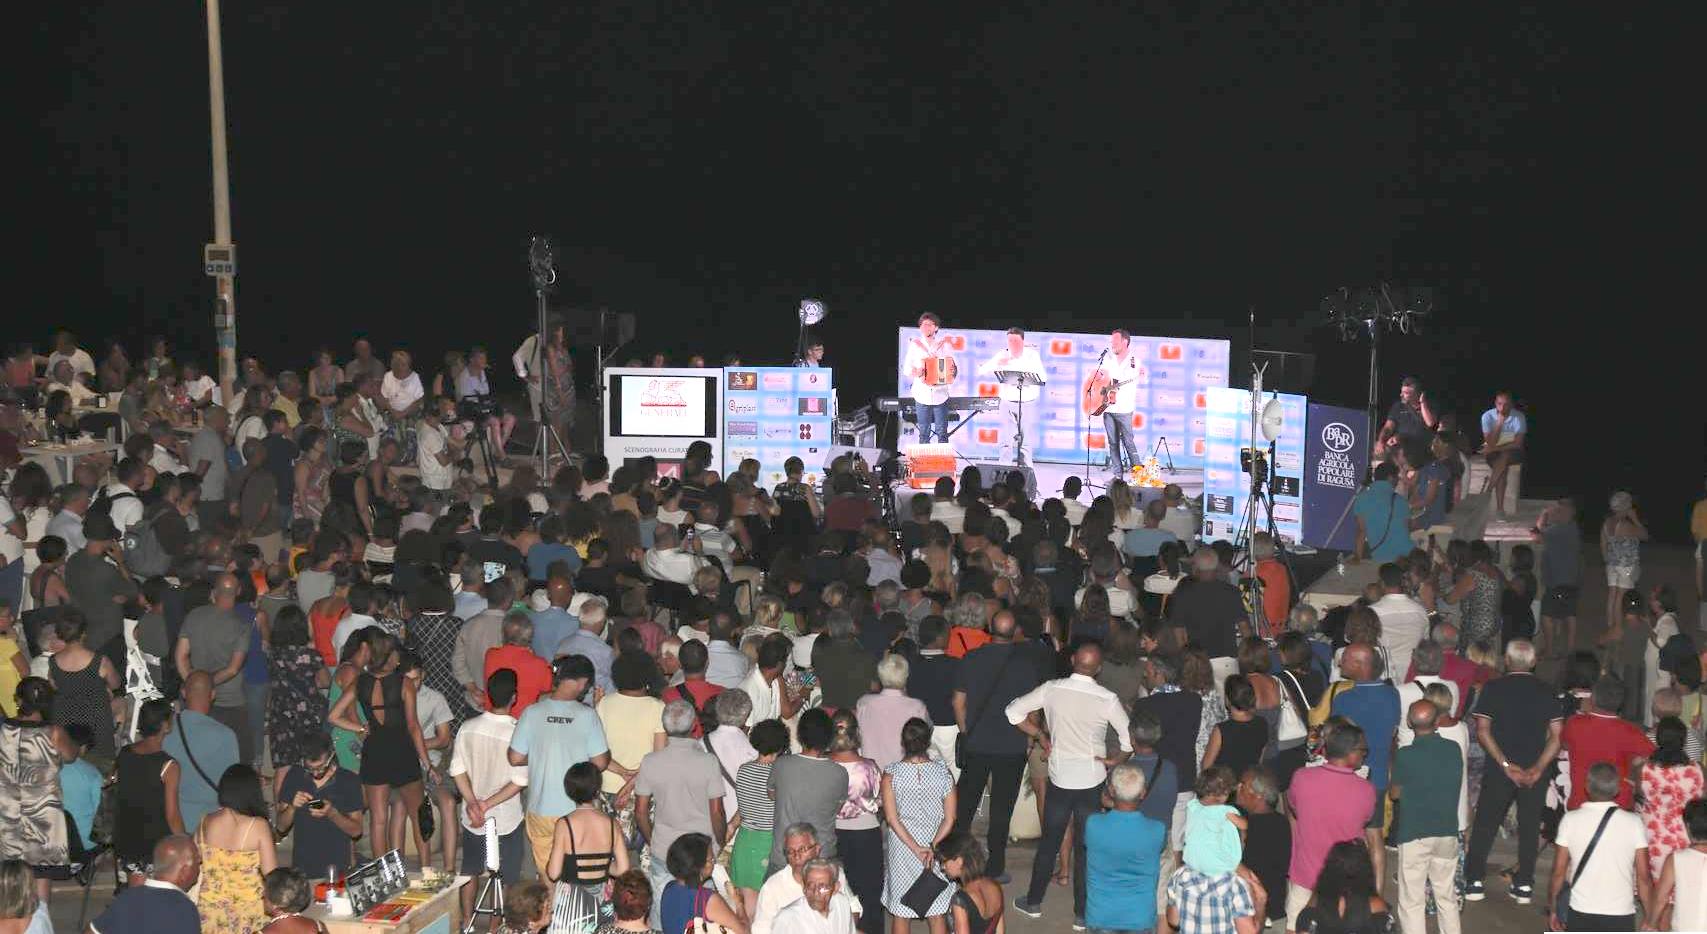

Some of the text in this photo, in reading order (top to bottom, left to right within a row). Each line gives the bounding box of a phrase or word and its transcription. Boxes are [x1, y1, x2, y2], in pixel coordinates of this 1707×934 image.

[623, 446, 667, 454] SCENOGRAFIA
[1325, 451, 1349, 462] BANCA
[1319, 458, 1355, 470] AGRICOLA
[1318, 466, 1355, 478] POPOLARE
[1318, 473, 1326, 482] DI
[1327, 475, 1355, 486] RAGUSA
[546, 715, 575, 725] CREW
